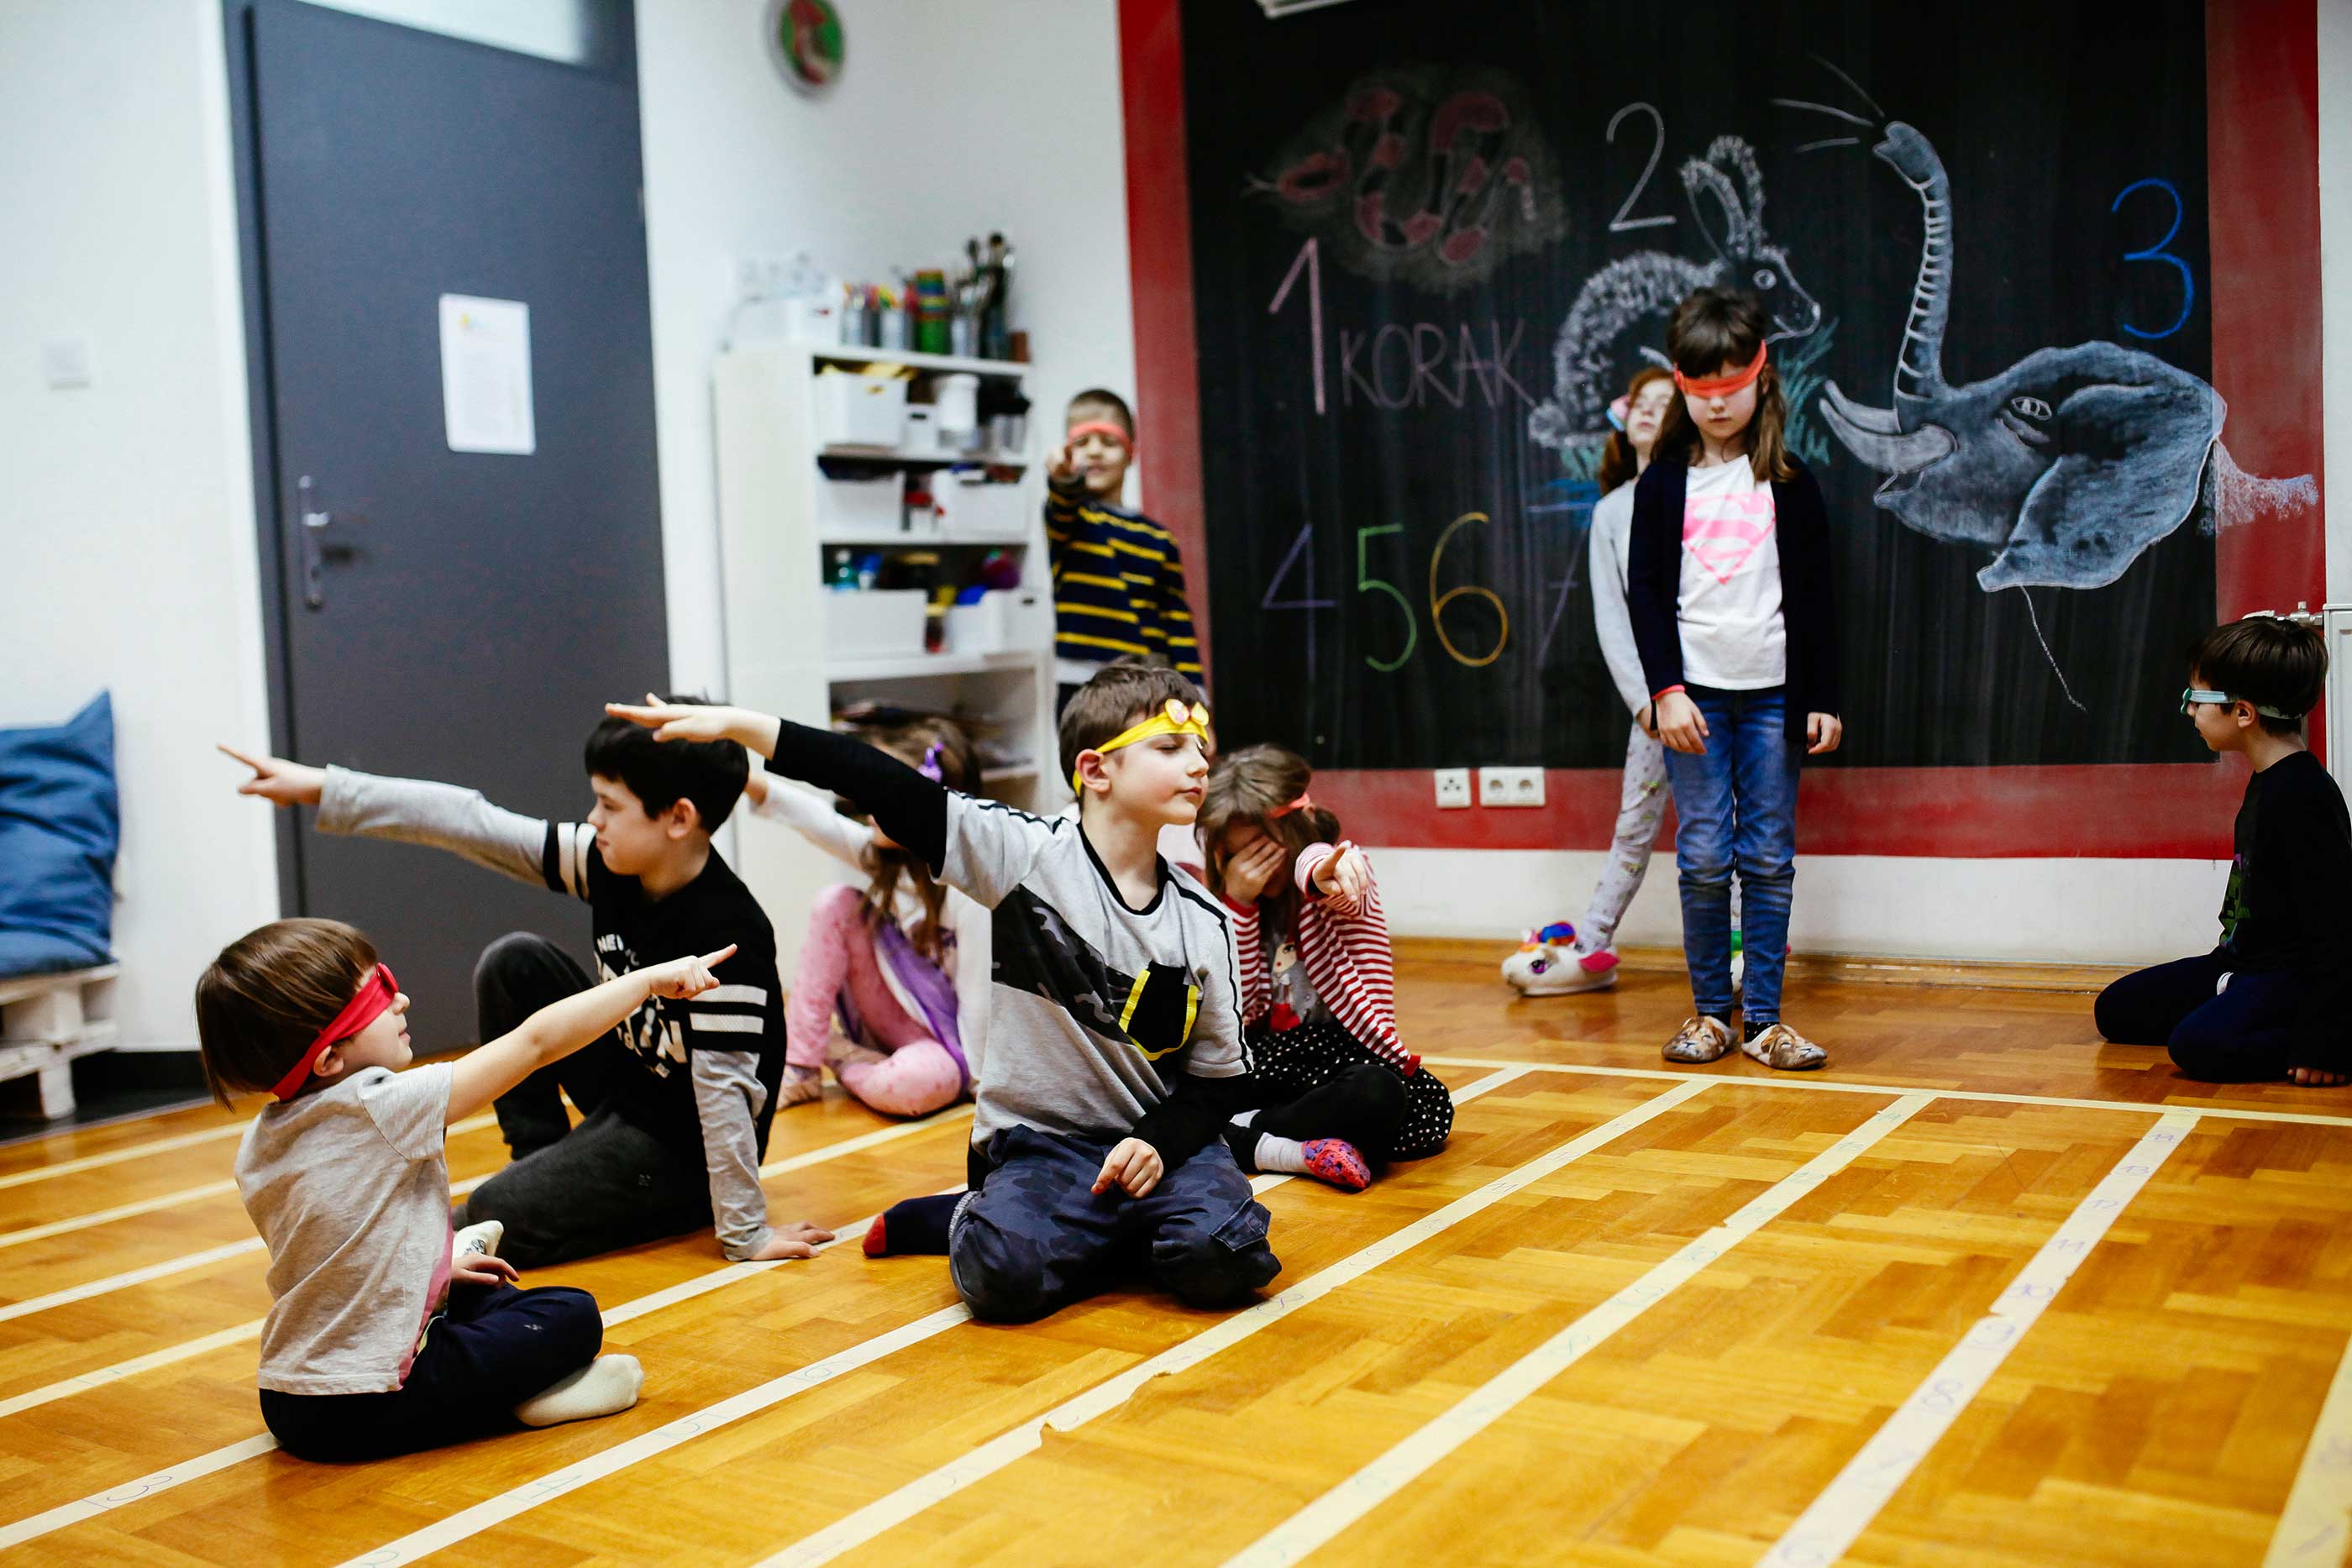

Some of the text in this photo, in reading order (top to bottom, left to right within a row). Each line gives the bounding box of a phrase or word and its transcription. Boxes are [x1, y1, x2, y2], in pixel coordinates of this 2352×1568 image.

[1606, 101, 1677, 232] 2
[1268, 237, 1538, 416] 1 KORAK
[2111, 177, 2194, 339] 3
[1263, 502, 1596, 681] 4 5 6 7
[2121, 1164, 2150, 1175] 13
[108, 1476, 172, 1502] 3
